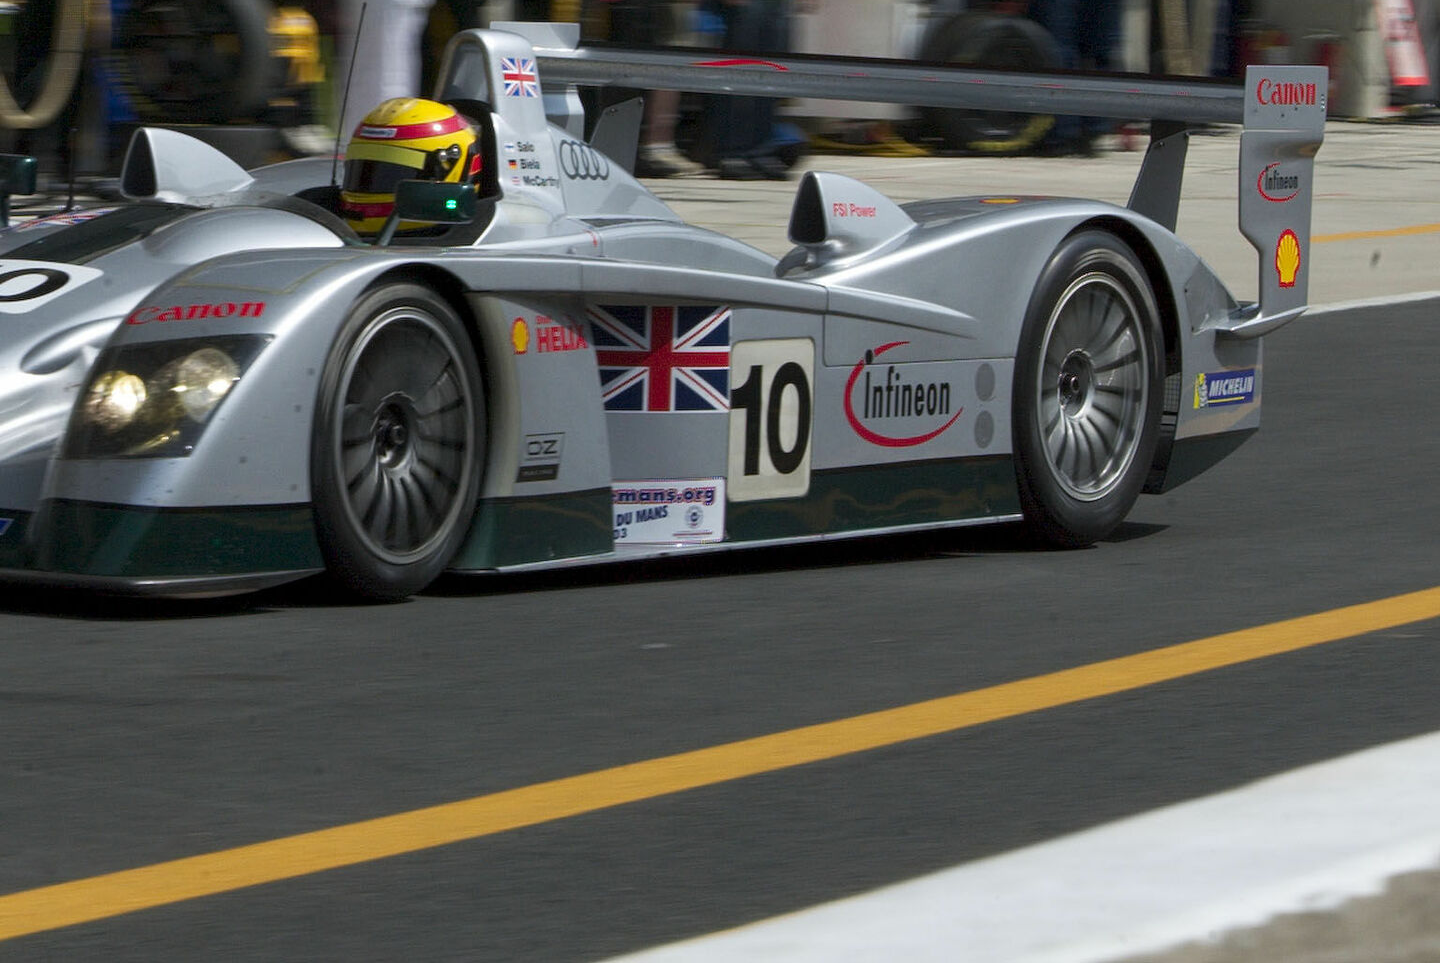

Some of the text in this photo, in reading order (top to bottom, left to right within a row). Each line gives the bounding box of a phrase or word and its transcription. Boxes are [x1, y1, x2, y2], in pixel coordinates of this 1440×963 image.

[1257, 78, 1317, 106] Canon
[520, 158, 541, 170] Biela
[1265, 166, 1299, 191] Infineon
[832, 202, 876, 218] FSI Power
[126, 300, 266, 326] Canon
[535, 323, 590, 353] HELIX
[863, 349, 951, 420] Infineon
[1208, 376, 1254, 397] MICHELIN
[731, 361, 811, 477] 10
[527, 439, 558, 456] OZ
[616, 505, 669, 527] DU MANS
